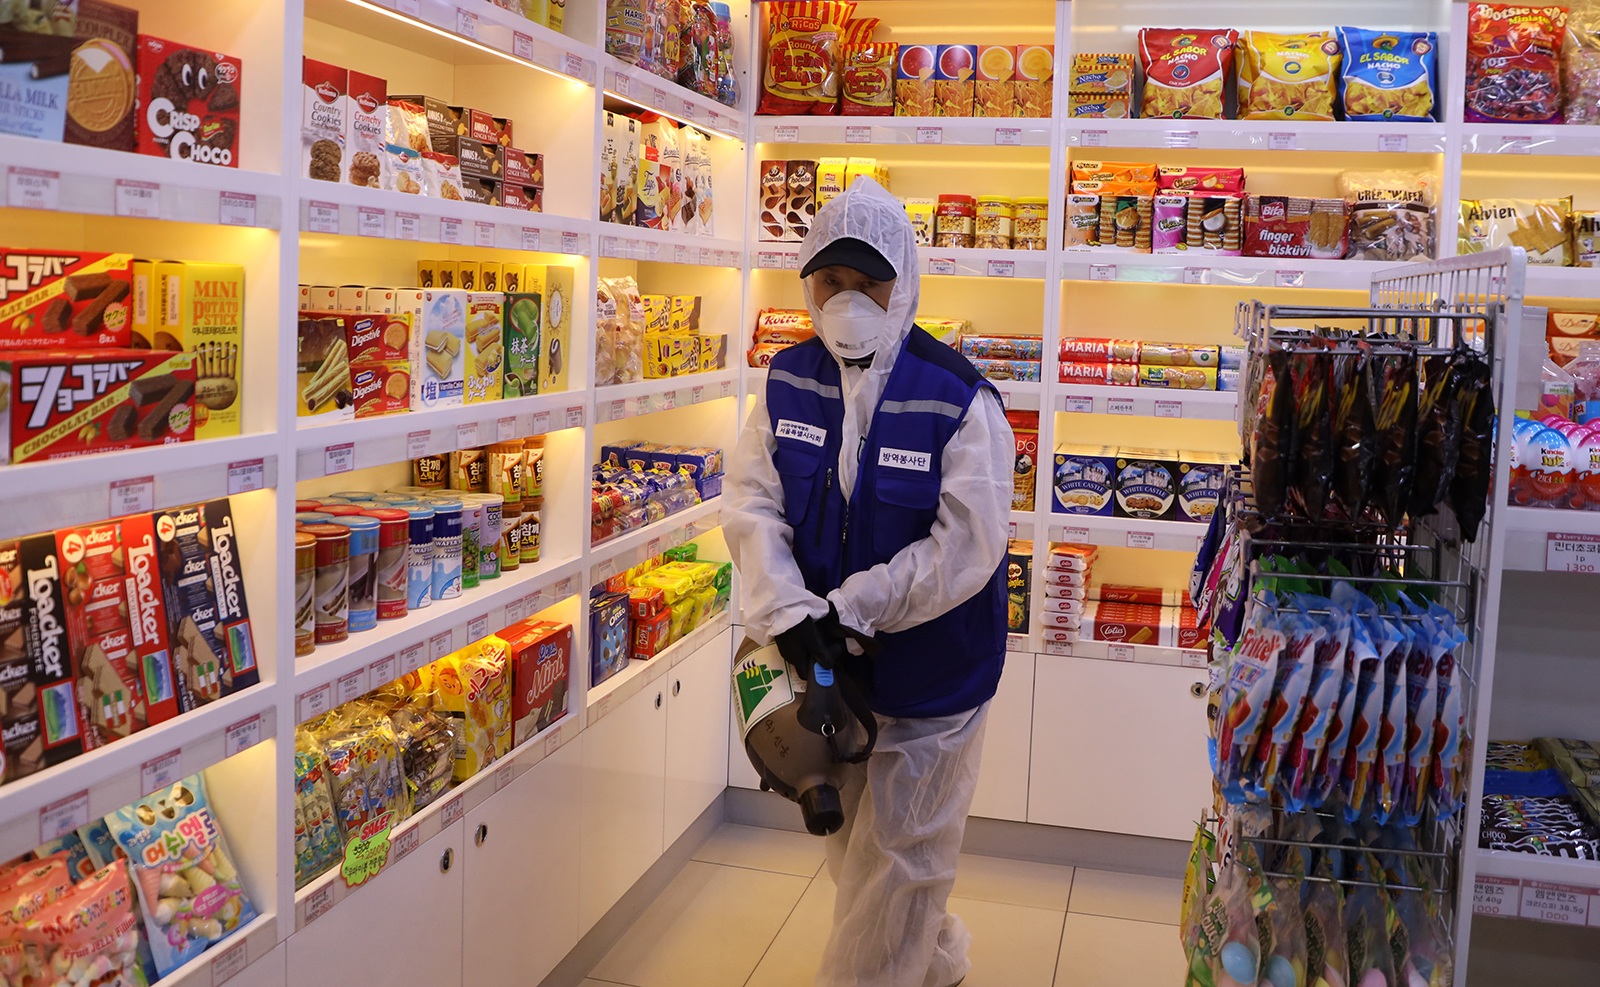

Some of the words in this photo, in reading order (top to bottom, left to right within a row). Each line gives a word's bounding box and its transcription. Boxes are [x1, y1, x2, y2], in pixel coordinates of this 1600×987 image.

[789, 41, 817, 52] Round
[1160, 53, 1171, 61] EL
[1173, 46, 1208, 56] SABOR
[772, 48, 824, 68] Nacho
[1168, 54, 1198, 65] NACHO
[1359, 53, 1371, 63] EL
[1373, 52, 1409, 65] SABOR
[1367, 62, 1401, 70] NACHO
[774, 65, 823, 86] Chips
[1078, 74, 1101, 83] Nacho
[313, 101, 341, 116] Country
[1077, 104, 1100, 114] Nacho
[147, 97, 200, 138] CRISP
[311, 111, 342, 126] Cookies
[354, 111, 382, 127] Crunchy
[353, 120, 382, 135] Cookies
[170, 131, 232, 165] CHOCO
[1262, 206, 1284, 217] Bifa
[1469, 205, 1517, 220] Alvien
[1260, 230, 1294, 243] finger
[1269, 244, 1311, 256] bisküvi
[194, 281, 238, 298] MINI
[192, 300, 239, 326] POTATO
[204, 313, 238, 326] STICK
[351, 327, 381, 347] Digestive
[836, 341, 849, 350] 3M
[1064, 342, 1105, 353] MARIA
[1063, 366, 1104, 378] MARIA
[353, 378, 382, 399] Digestive
[22, 412, 90, 455] CHOCOLAT
[91, 396, 116, 416] BAR
[780, 428, 822, 442] 서울특별시지회
[420, 458, 441, 473] 참깨
[883, 452, 926, 467] 방역봉사단
[1062, 481, 1082, 491] WHITE
[1083, 482, 1105, 493] CASTLE
[1123, 486, 1143, 495] WHITE
[1144, 486, 1166, 498] CASTLE
[1187, 491, 1207, 500] WHITE
[173, 511, 198, 527] cker
[84, 529, 113, 545] cker
[521, 522, 540, 537] 참깨
[1575, 554, 1586, 563] 1p
[184, 559, 206, 574] cker
[212, 516, 241, 618] Loacker
[1566, 563, 1595, 573] 1300
[94, 581, 120, 598] cker
[128, 533, 159, 646] Loacker
[27, 555, 63, 678] Loacker
[192, 607, 214, 622] cker
[609, 608, 626, 627] OREO
[1104, 625, 1124, 636] Lotus
[29, 607, 43, 672] FONDENTE
[101, 632, 126, 650] cker
[361, 813, 394, 841] SALE!
[1481, 830, 1507, 840] CHOCO
[1474, 884, 1504, 895] 앤엠즈
[1485, 896, 1502, 904] 40g
[1526, 900, 1556, 911] 크리스피
[1560, 905, 1584, 915] 38.5g
[1472, 905, 1500, 914] 1000
[1540, 911, 1569, 921] 1000
